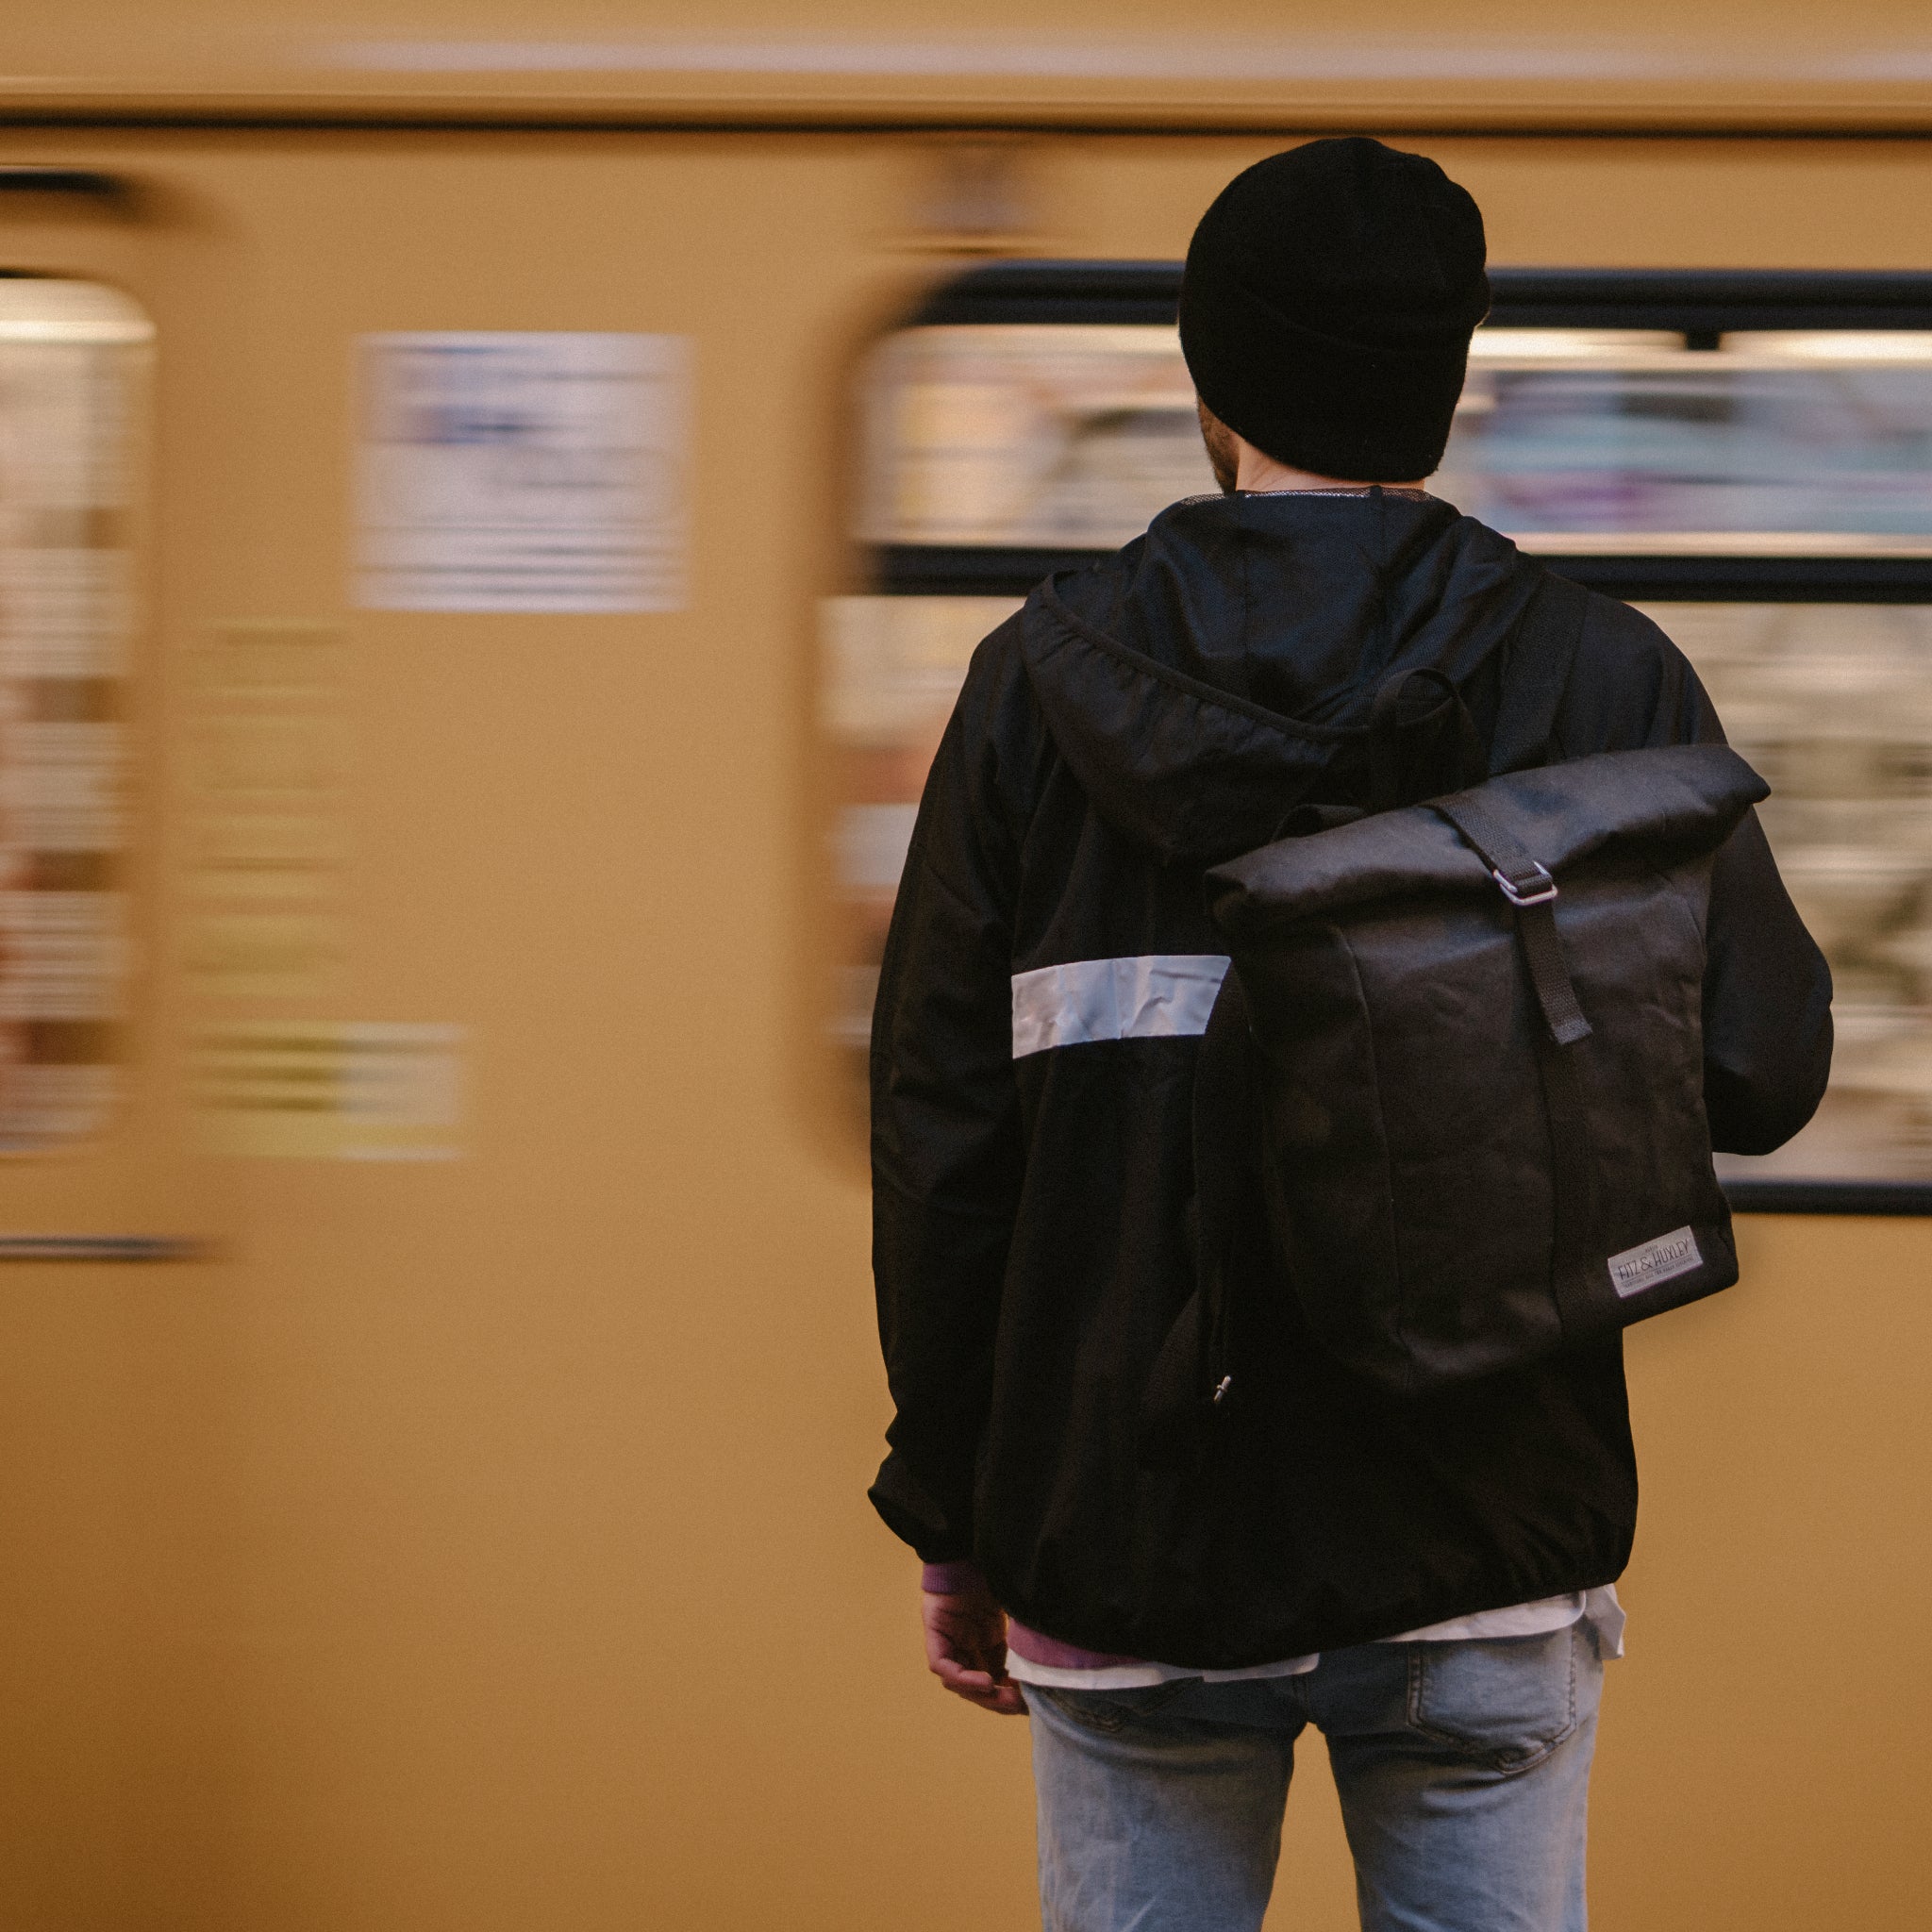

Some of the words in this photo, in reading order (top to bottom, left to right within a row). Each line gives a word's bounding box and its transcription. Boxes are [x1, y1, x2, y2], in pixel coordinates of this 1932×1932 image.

[1618, 1260, 1641, 1280] FITZ
[1641, 1256, 1653, 1272] &
[1652, 1239, 1690, 1267] HUXLEY
